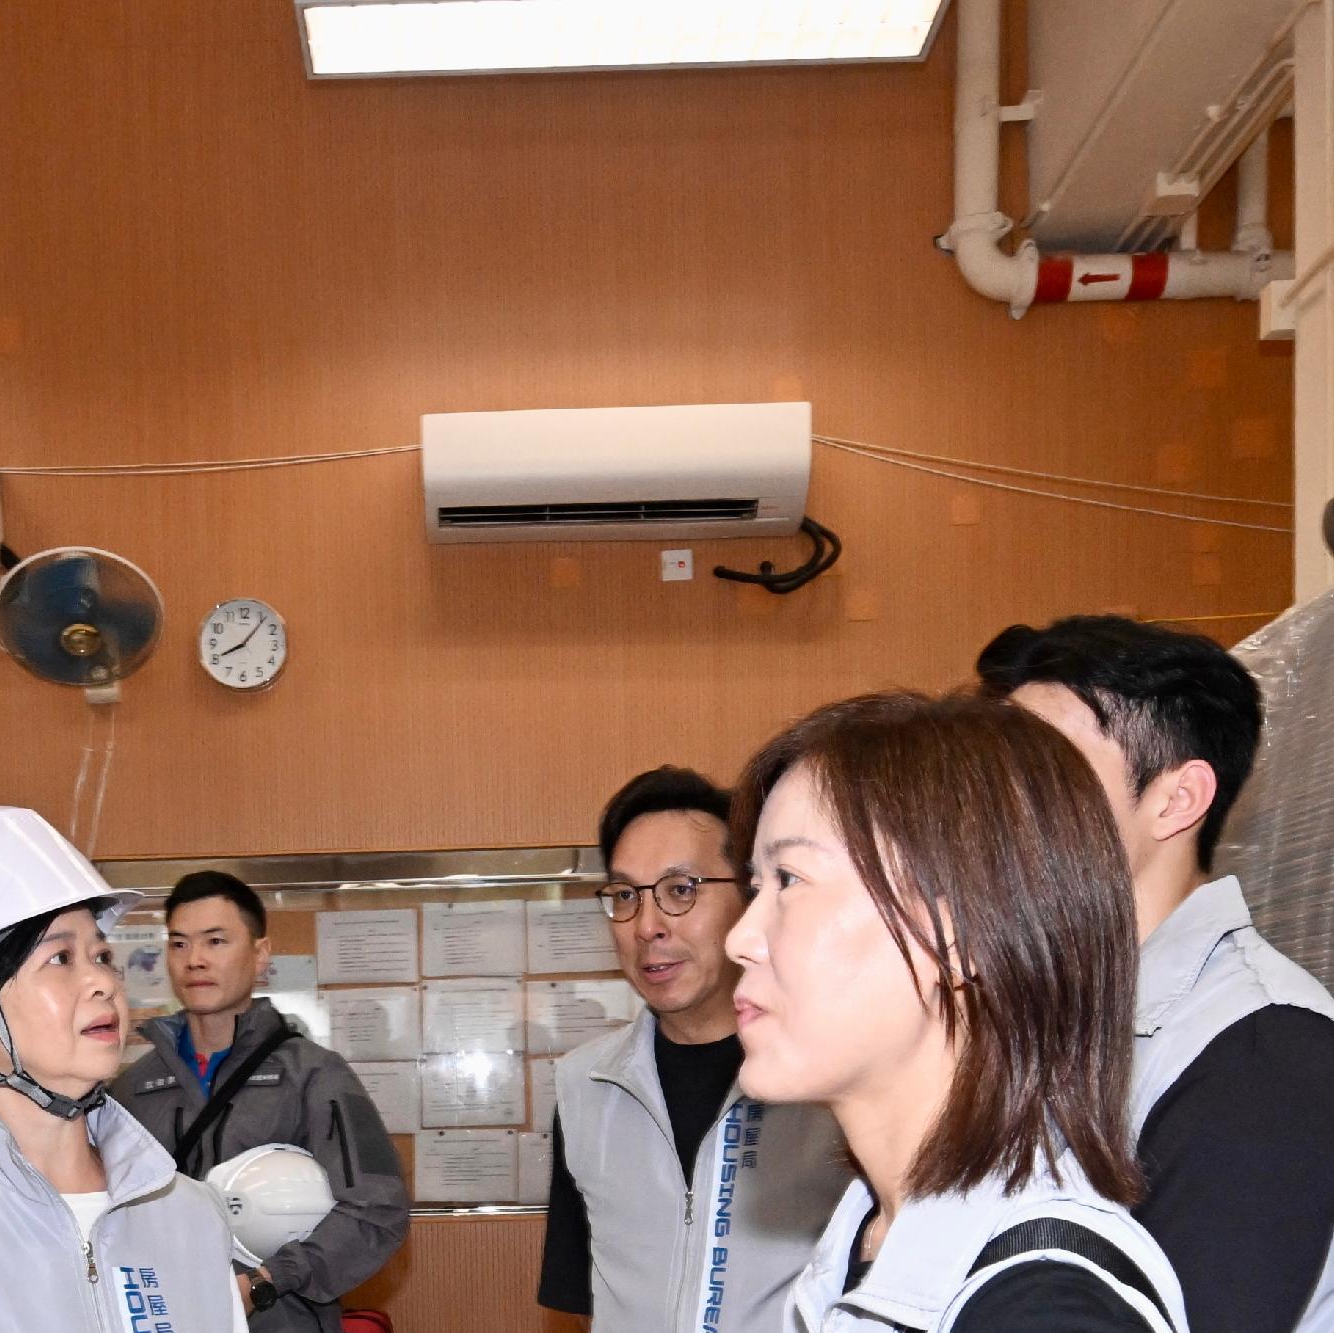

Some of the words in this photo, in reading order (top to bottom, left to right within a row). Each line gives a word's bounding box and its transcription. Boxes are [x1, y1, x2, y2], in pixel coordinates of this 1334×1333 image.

[238, 607, 249, 619] 12
[212, 622, 223, 634] 10
[267, 623, 277, 635] 2
[210, 638, 217, 649] 9
[270, 639, 278, 651] 3
[211, 653, 219, 665] 8
[267, 654, 275, 666] 4
[224, 666, 233, 676] 7
[239, 670, 246, 681] 6
[254, 666, 263, 677] 5
[714, 1103, 744, 1238] HOUSING
